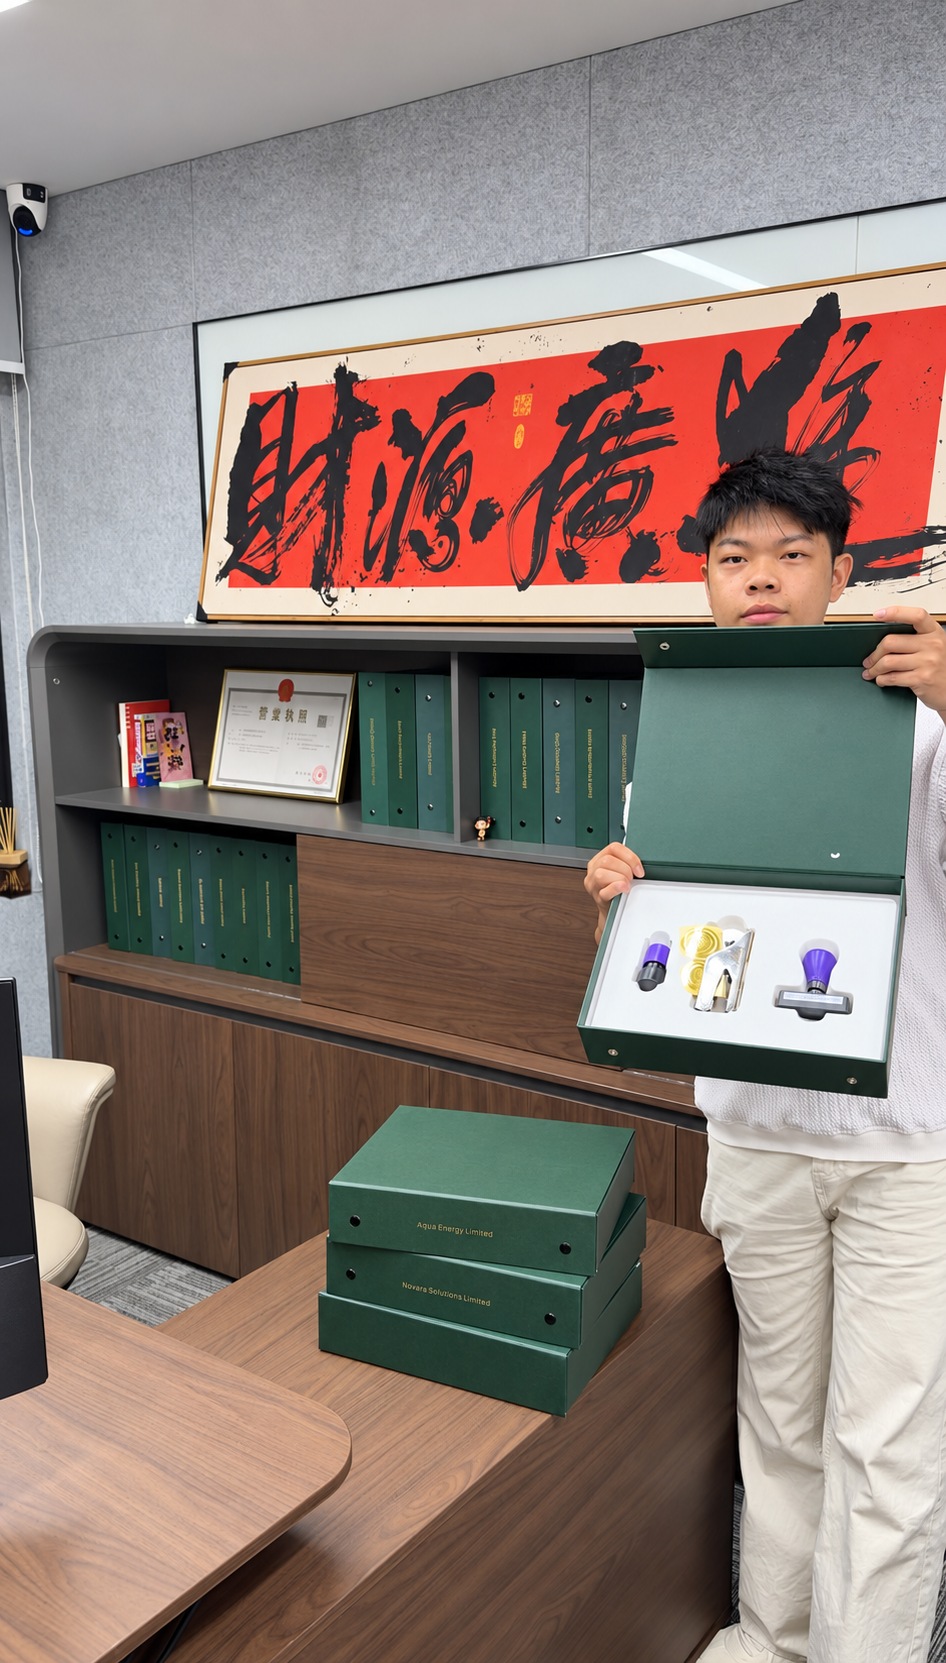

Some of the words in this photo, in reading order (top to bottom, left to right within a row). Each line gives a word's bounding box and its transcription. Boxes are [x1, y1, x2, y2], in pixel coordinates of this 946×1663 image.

[416, 1221, 437, 1231] Aqua
[438, 1223, 464, 1235] Energy
[465, 1228, 494, 1238] Limited
[402, 1281, 428, 1293] Novara
[428, 1287, 462, 1301] Solutions
[463, 1294, 491, 1307] Limited
